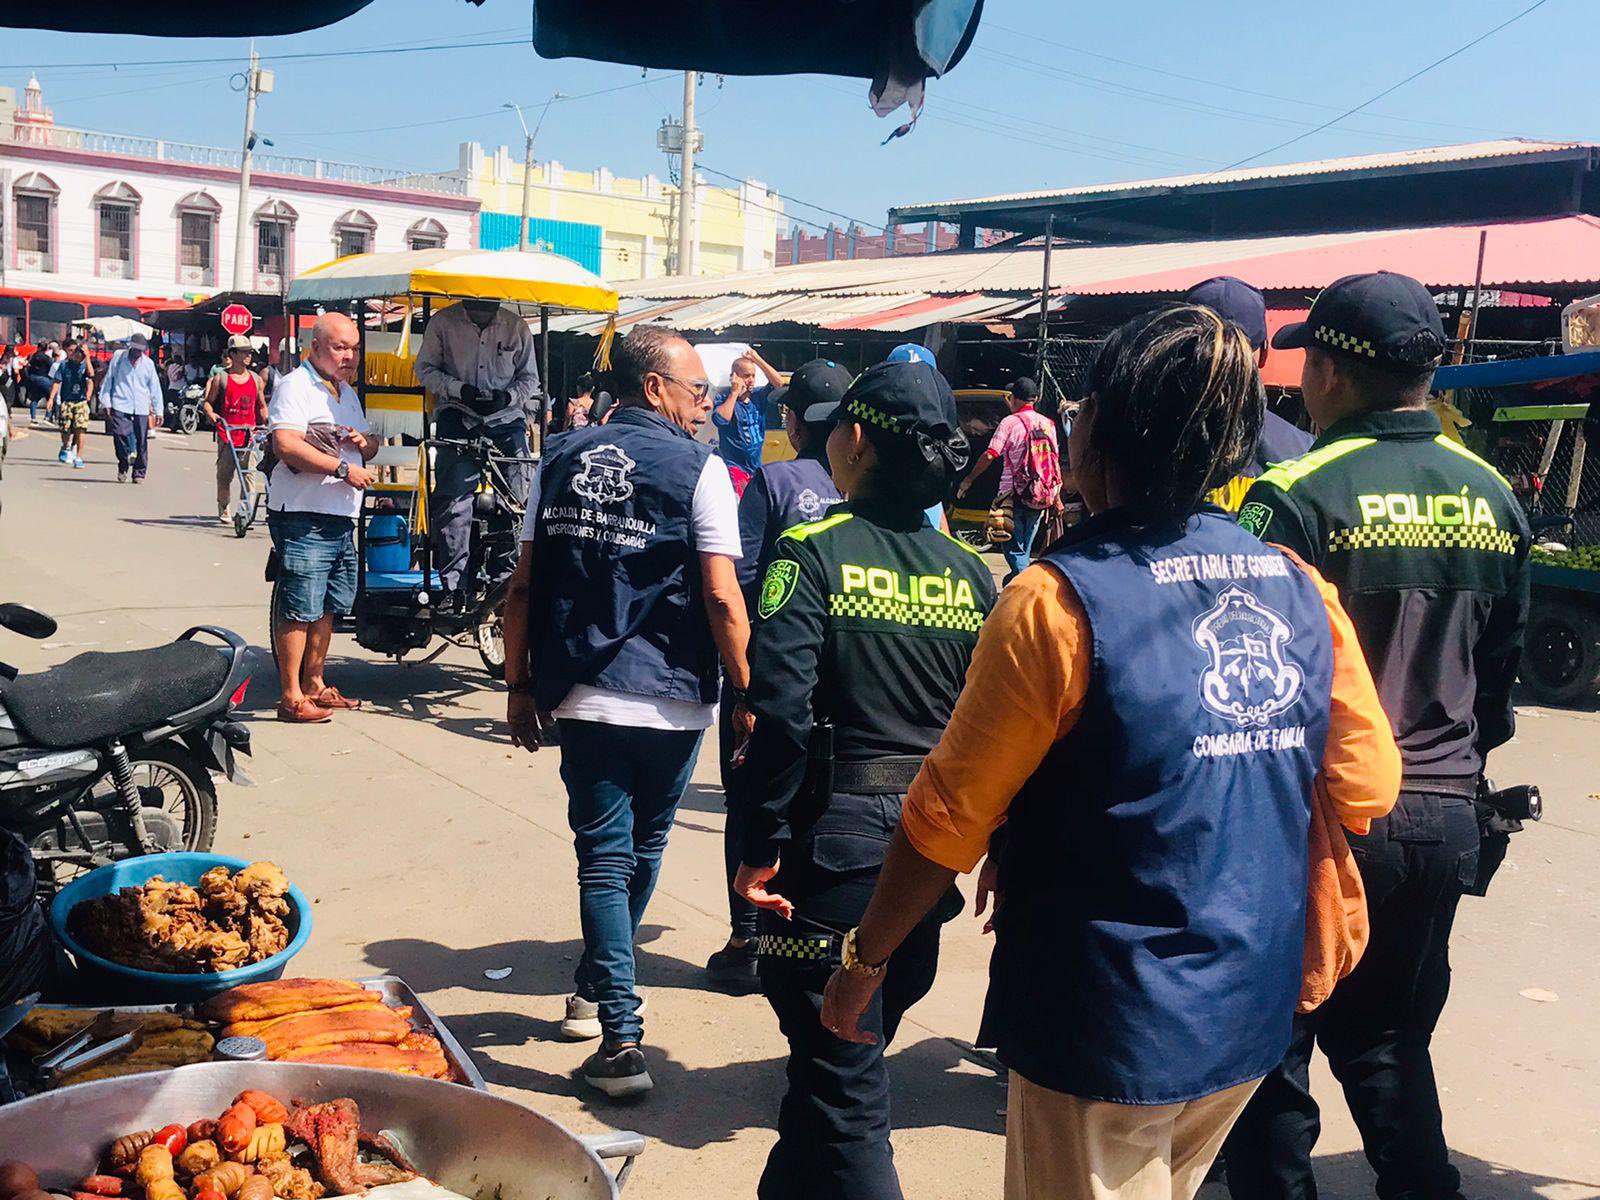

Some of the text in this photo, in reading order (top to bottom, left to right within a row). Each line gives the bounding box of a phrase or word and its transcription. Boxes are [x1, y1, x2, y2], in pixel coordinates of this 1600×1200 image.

[224, 313, 249, 327] PARE
[580, 508, 593, 521] DE
[1357, 484, 1497, 528] POLICÍA
[596, 528, 602, 541] Y
[1150, 554, 1231, 584] SECRETARIA
[1231, 554, 1248, 579] DE
[841, 564, 976, 609] POLICÍA
[1255, 730, 1270, 751] DE
